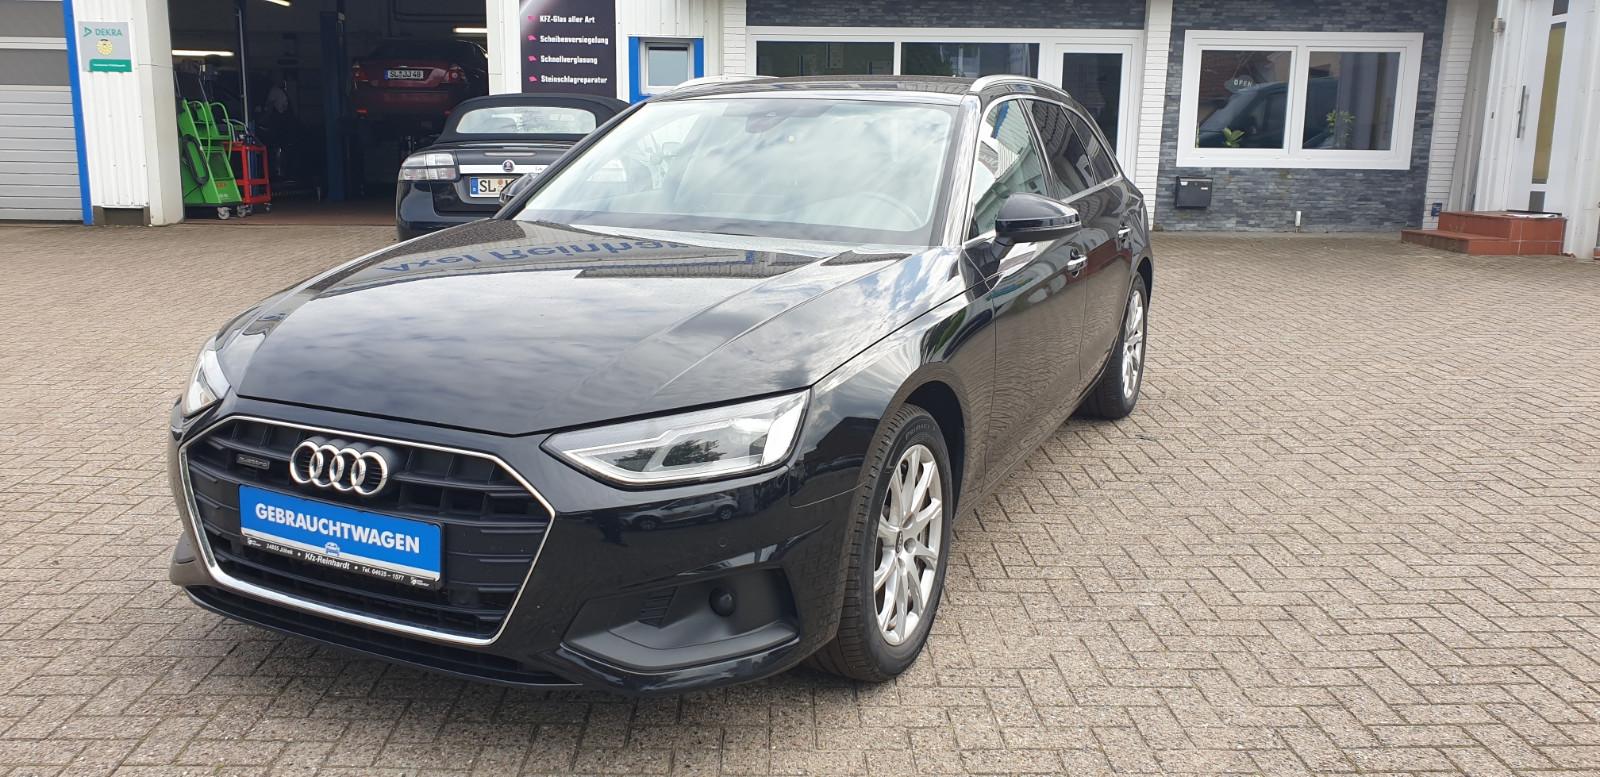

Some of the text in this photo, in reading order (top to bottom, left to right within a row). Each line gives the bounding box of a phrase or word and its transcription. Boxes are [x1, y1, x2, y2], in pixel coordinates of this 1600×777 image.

[540, 15, 567, 23] KFZ-Glas
[95, 28, 122, 36] DEKRA
[540, 35, 609, 45] Scheibenversiegelung
[540, 55, 598, 65] Schnellverglasung
[541, 75, 608, 85] Steinschlagreparatur
[1234, 79, 1253, 88] OPEN
[479, 179, 497, 193] SL
[255, 502, 420, 554] GEBRAUCHTWAGEN
[304, 552, 350, 570] Kfz-Reinhardt
